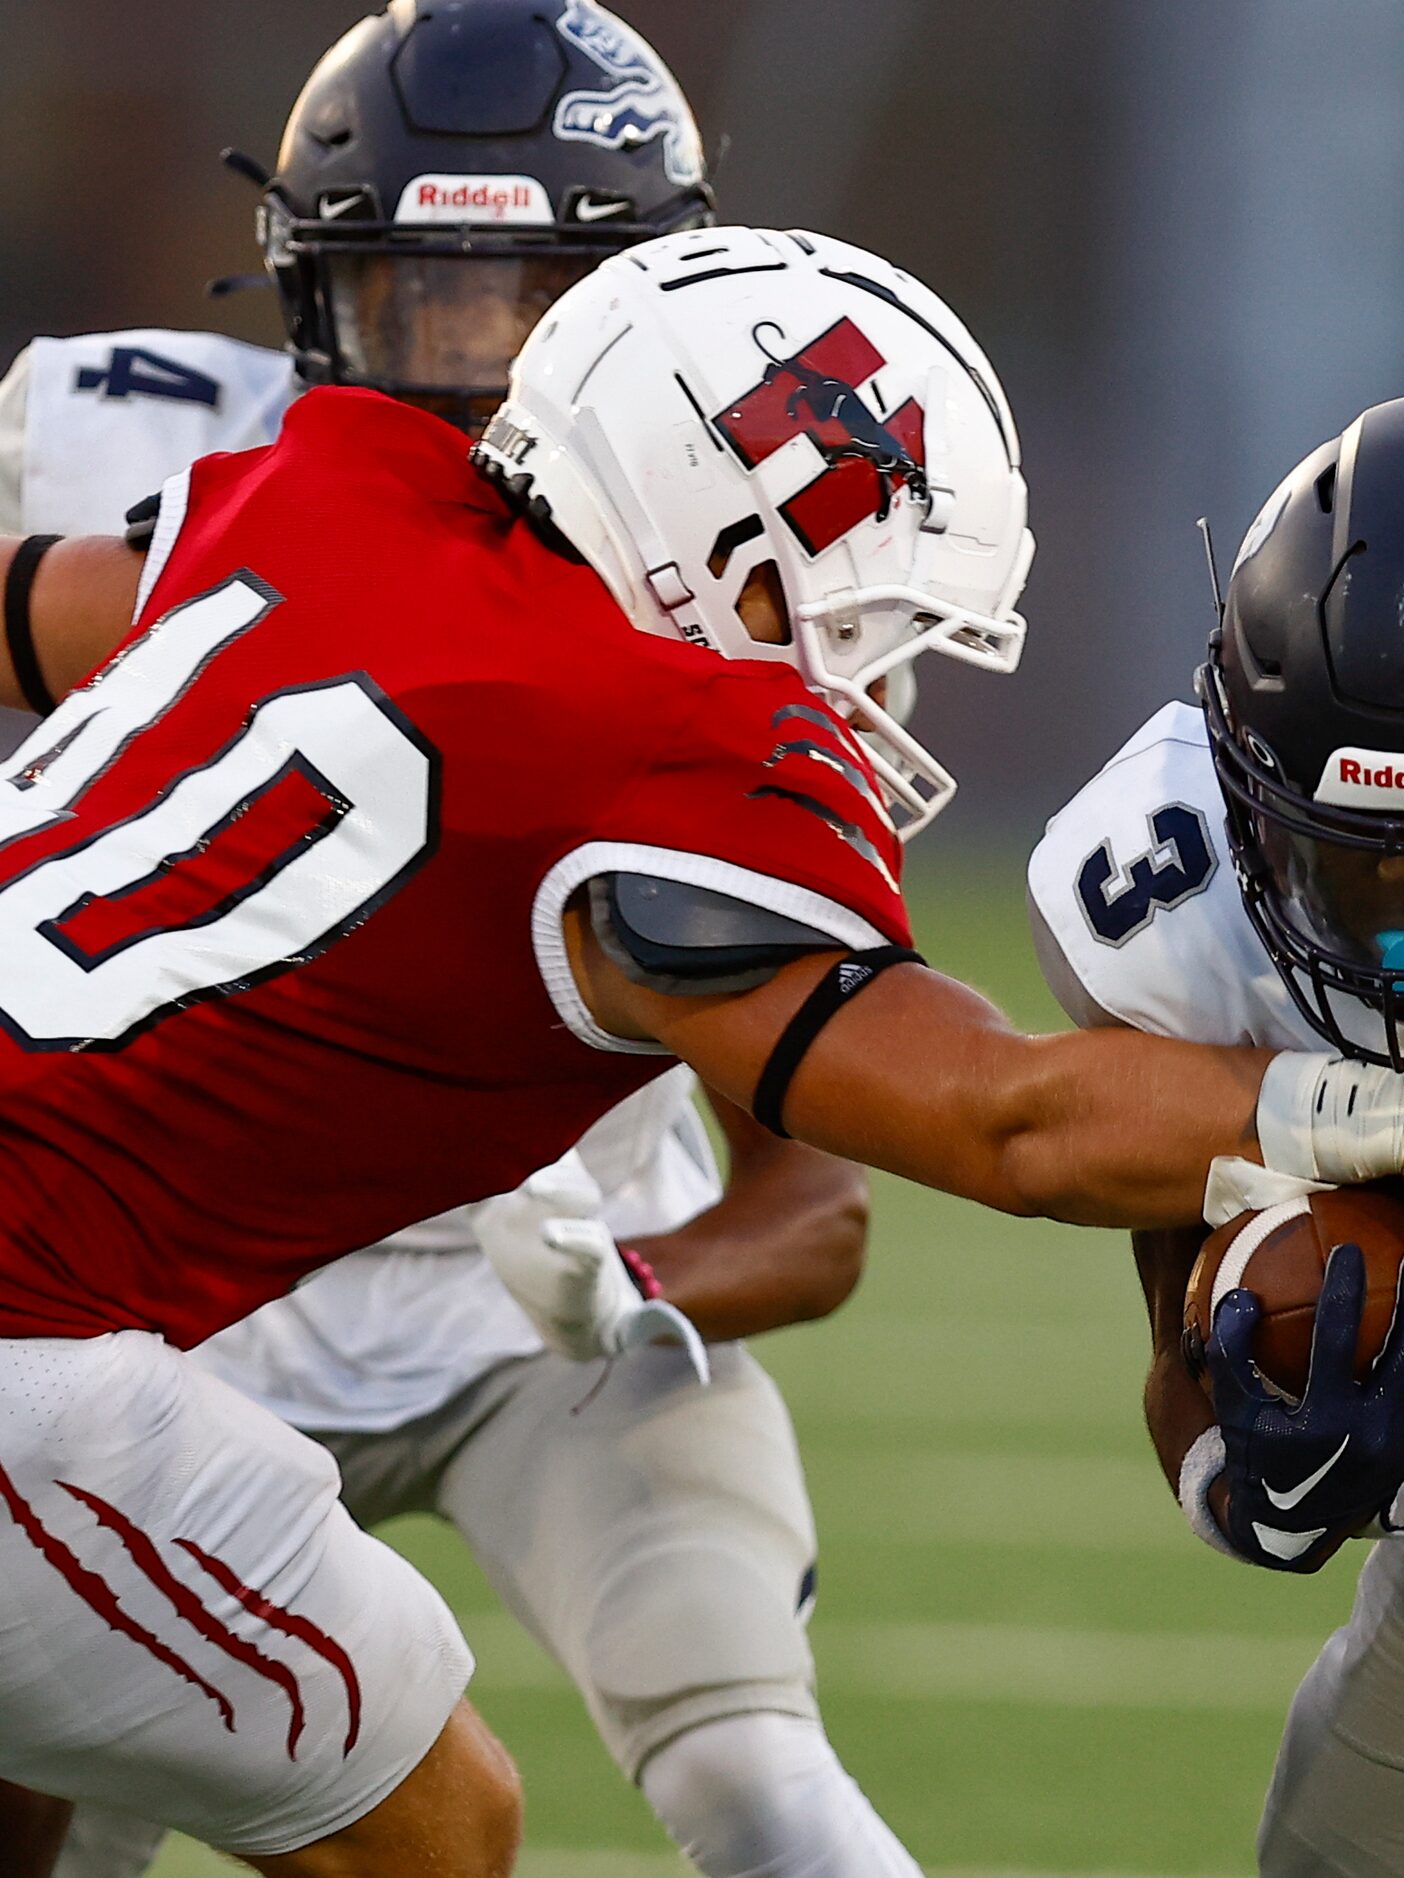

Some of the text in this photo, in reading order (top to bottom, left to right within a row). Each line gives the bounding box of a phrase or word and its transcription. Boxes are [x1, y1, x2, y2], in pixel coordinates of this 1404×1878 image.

[419, 184, 530, 207] Riddell
[74, 347, 221, 413] 4
[1072, 800, 1216, 949] 3
[841, 965, 873, 993] adidas
